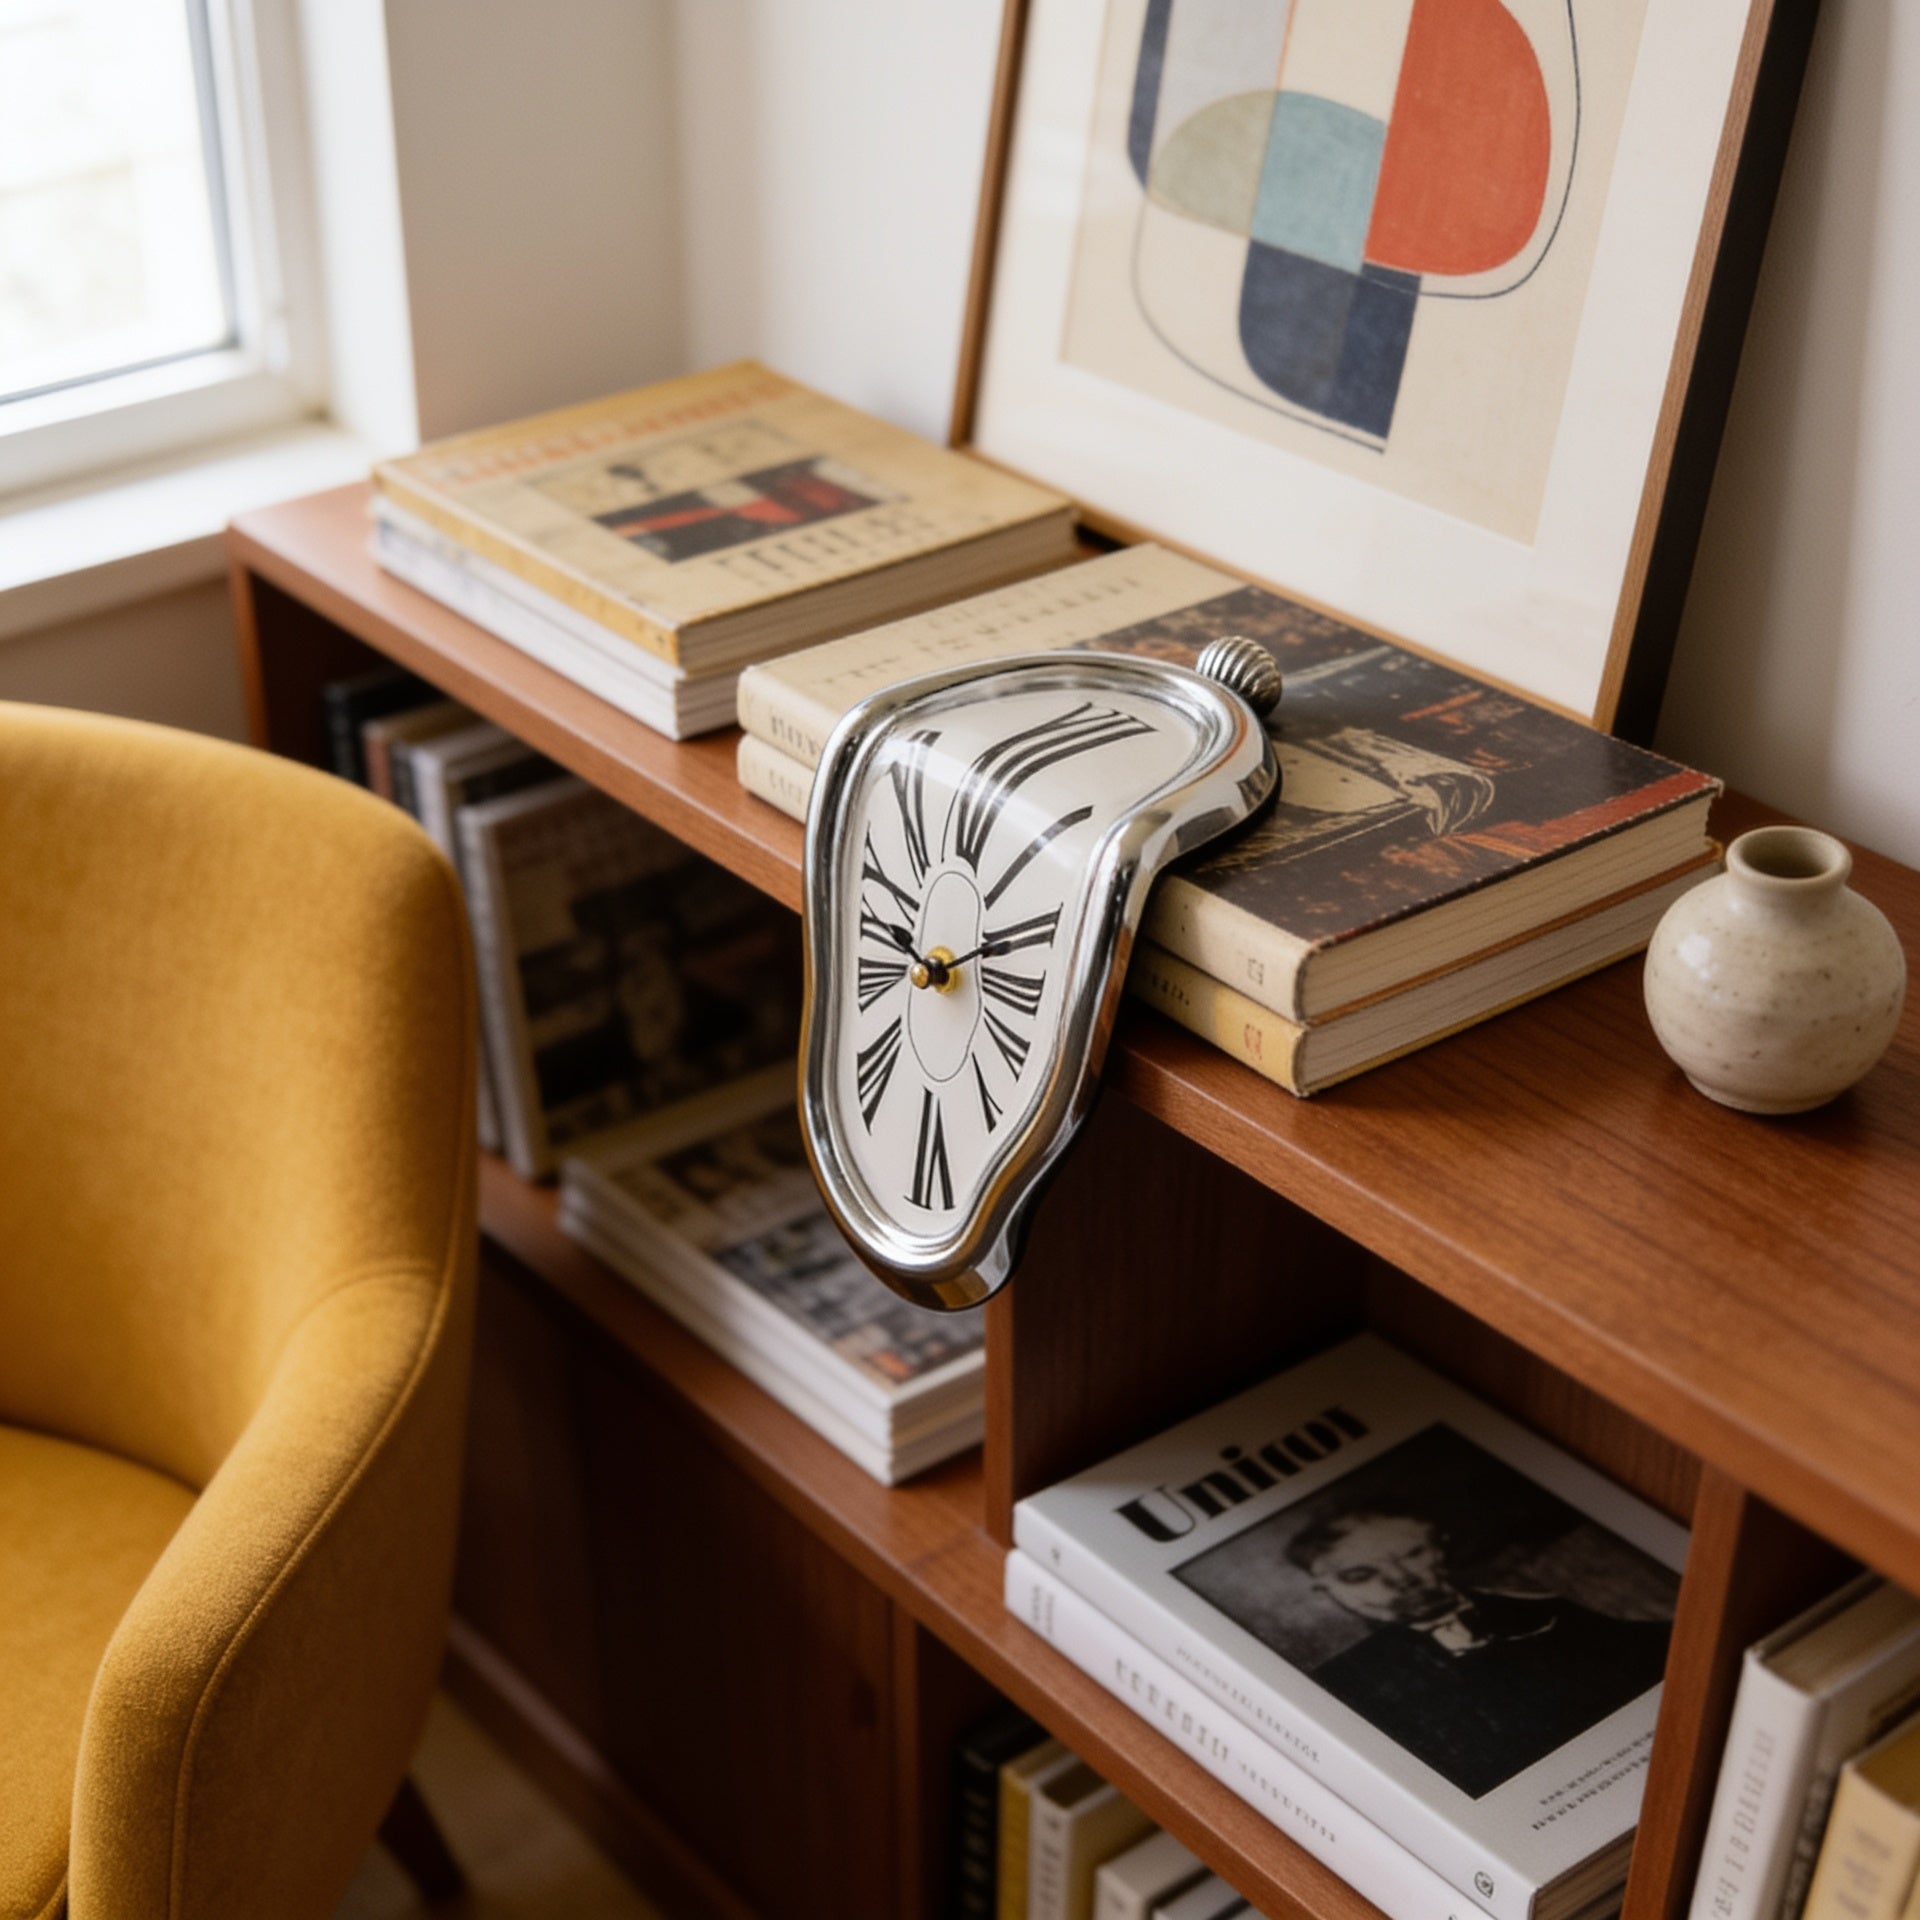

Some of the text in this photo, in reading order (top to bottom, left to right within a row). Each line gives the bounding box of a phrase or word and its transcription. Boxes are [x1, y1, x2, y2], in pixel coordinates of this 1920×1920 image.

[862, 821, 920, 929] X
[984, 805, 1094, 910] I
[981, 969, 1047, 1019] III
[984, 1006, 1031, 1082] IV
[857, 1014, 902, 1136] VII
[972, 1052, 1003, 1134] V
[903, 1085, 956, 1211] VI
